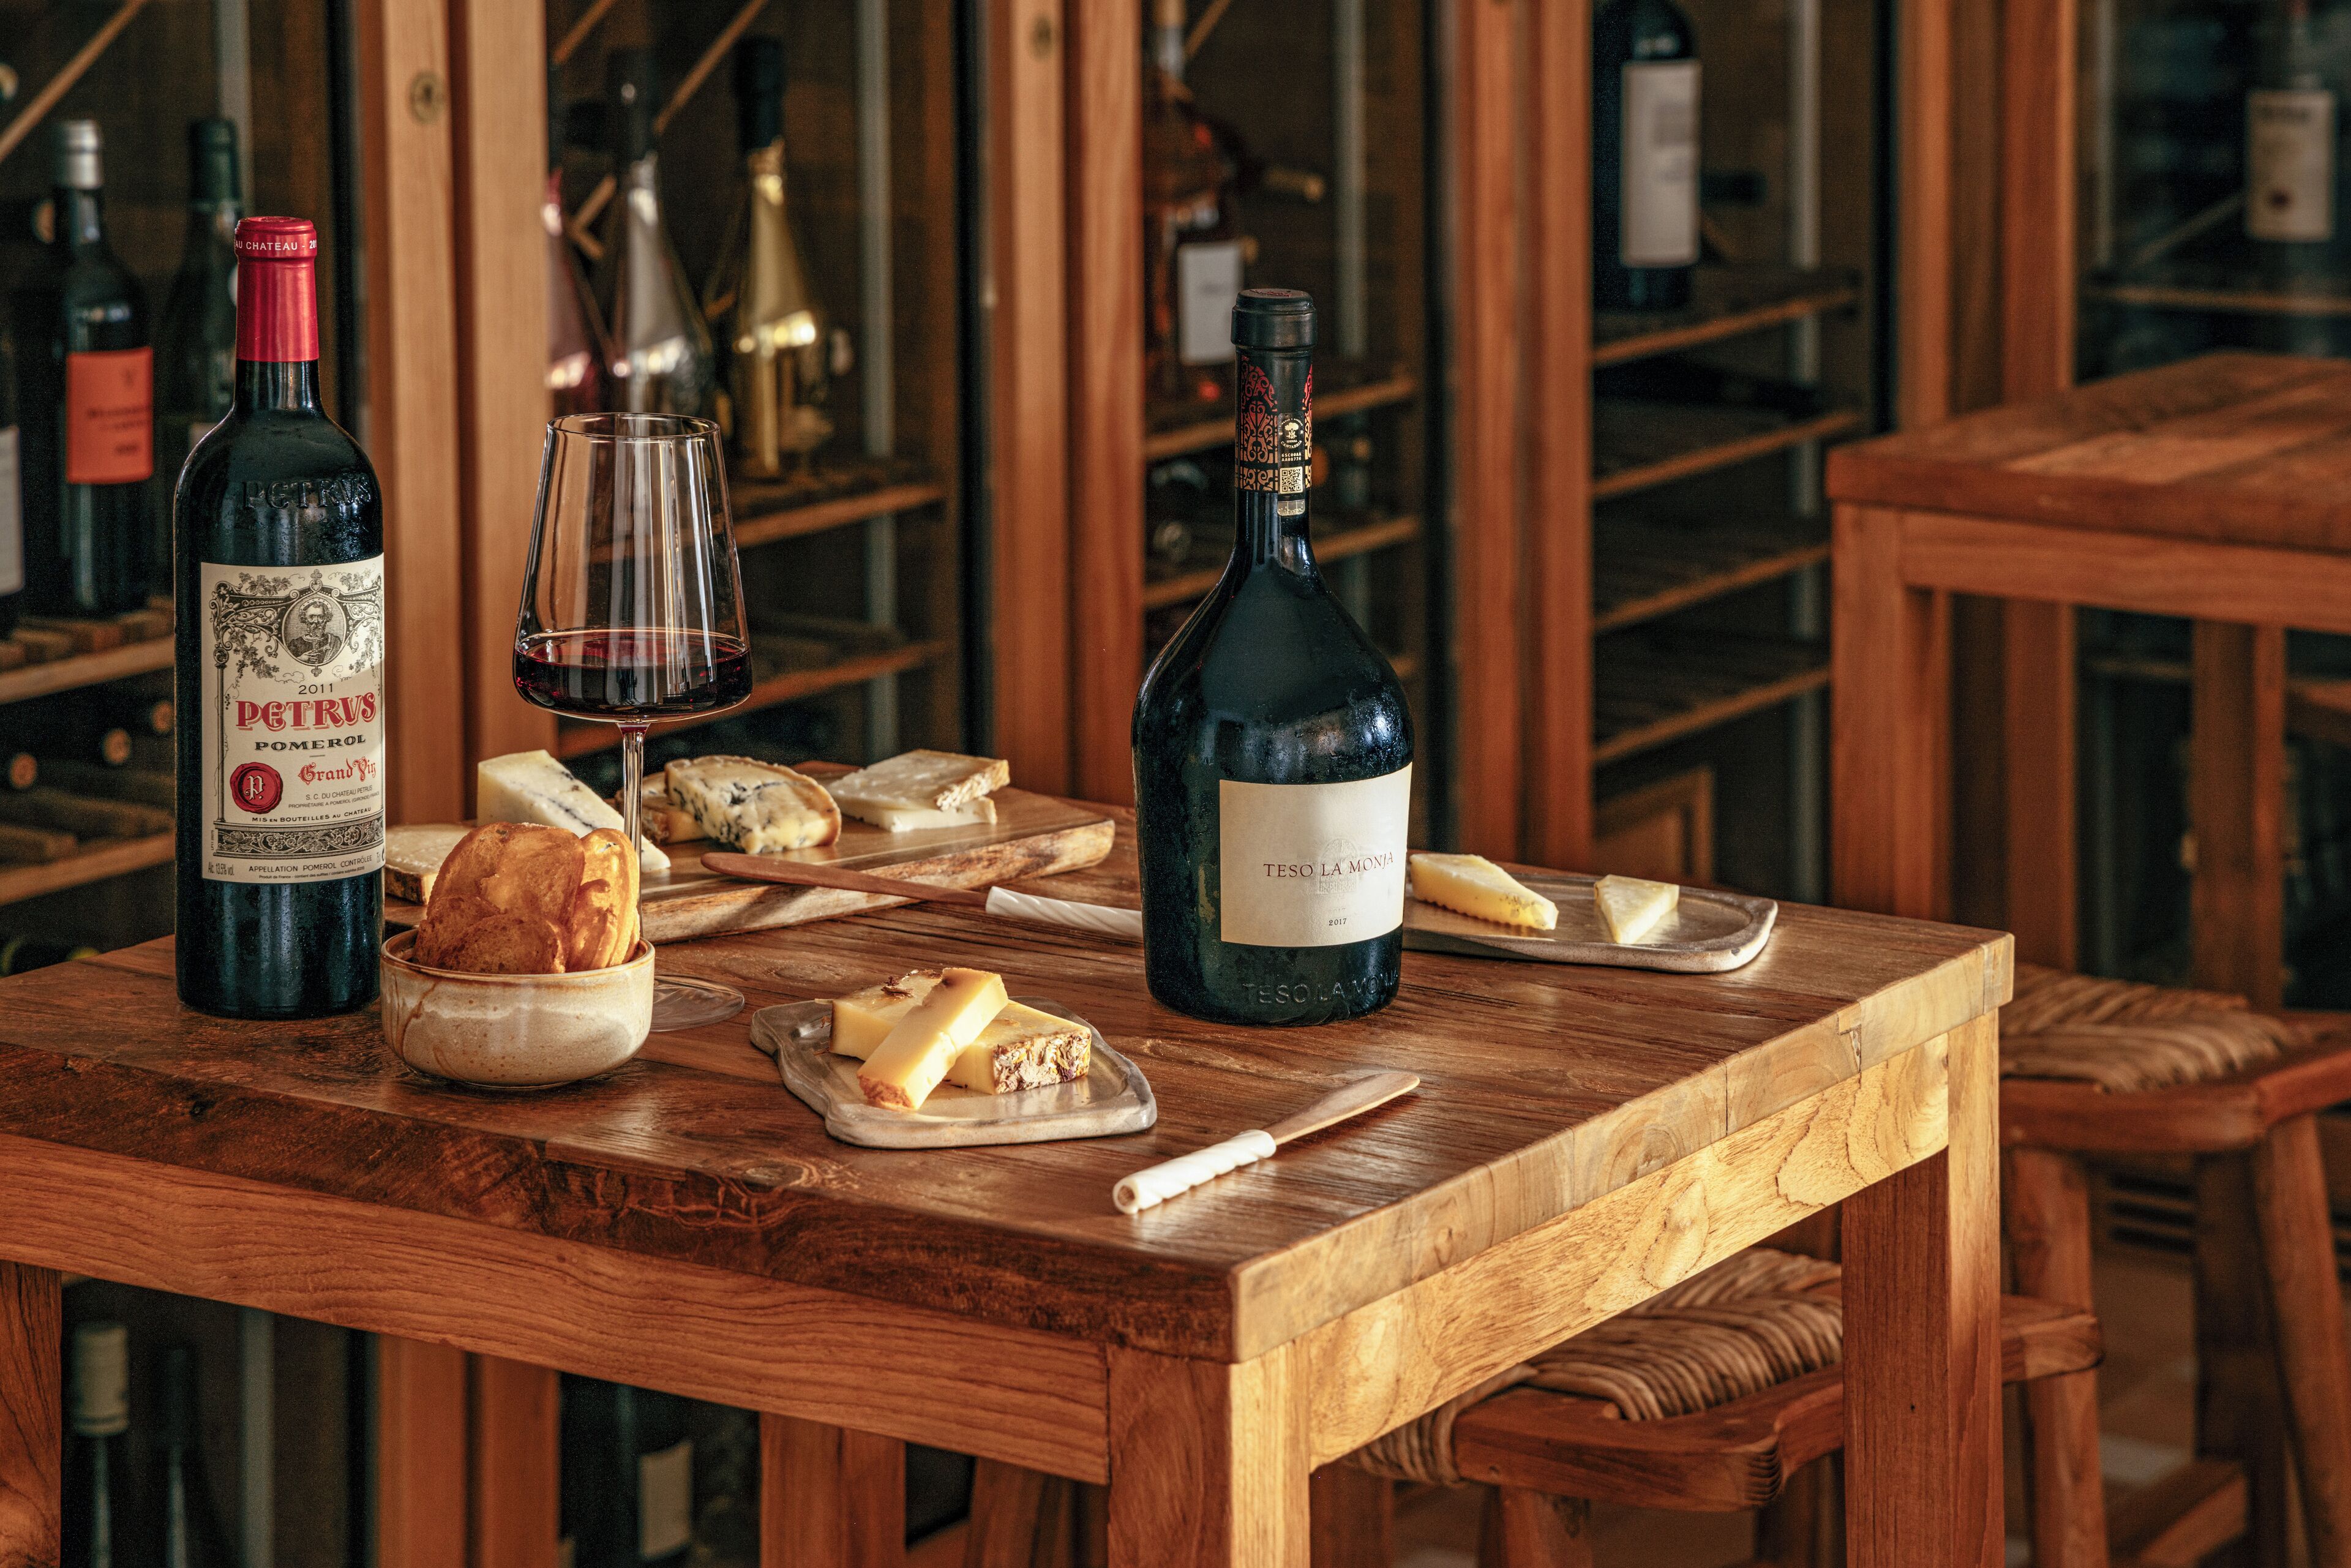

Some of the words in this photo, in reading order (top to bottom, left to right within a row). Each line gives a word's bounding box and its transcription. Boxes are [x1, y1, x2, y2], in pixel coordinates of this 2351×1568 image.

[235, 240, 242, 249] AU
[246, 241, 298, 250] CHATEAU
[1281, 440, 1302, 449] CANTABRIA
[298, 683, 333, 695] 2011
[255, 734, 366, 752] POMEROL
[298, 757, 353, 786] Grand
[353, 756, 377, 782] Vin
[332, 789, 356, 798] CHATEAU
[357, 785, 373, 794] PETRUS
[280, 814, 331, 822] BOUTEILLES
[344, 807, 372, 817] CHATEAU
[303, 862, 337, 871] POMEROL
[1263, 863, 1313, 877] TESO
[1322, 863, 1342, 876] LA
[1349, 852, 1393, 874] MONJA
